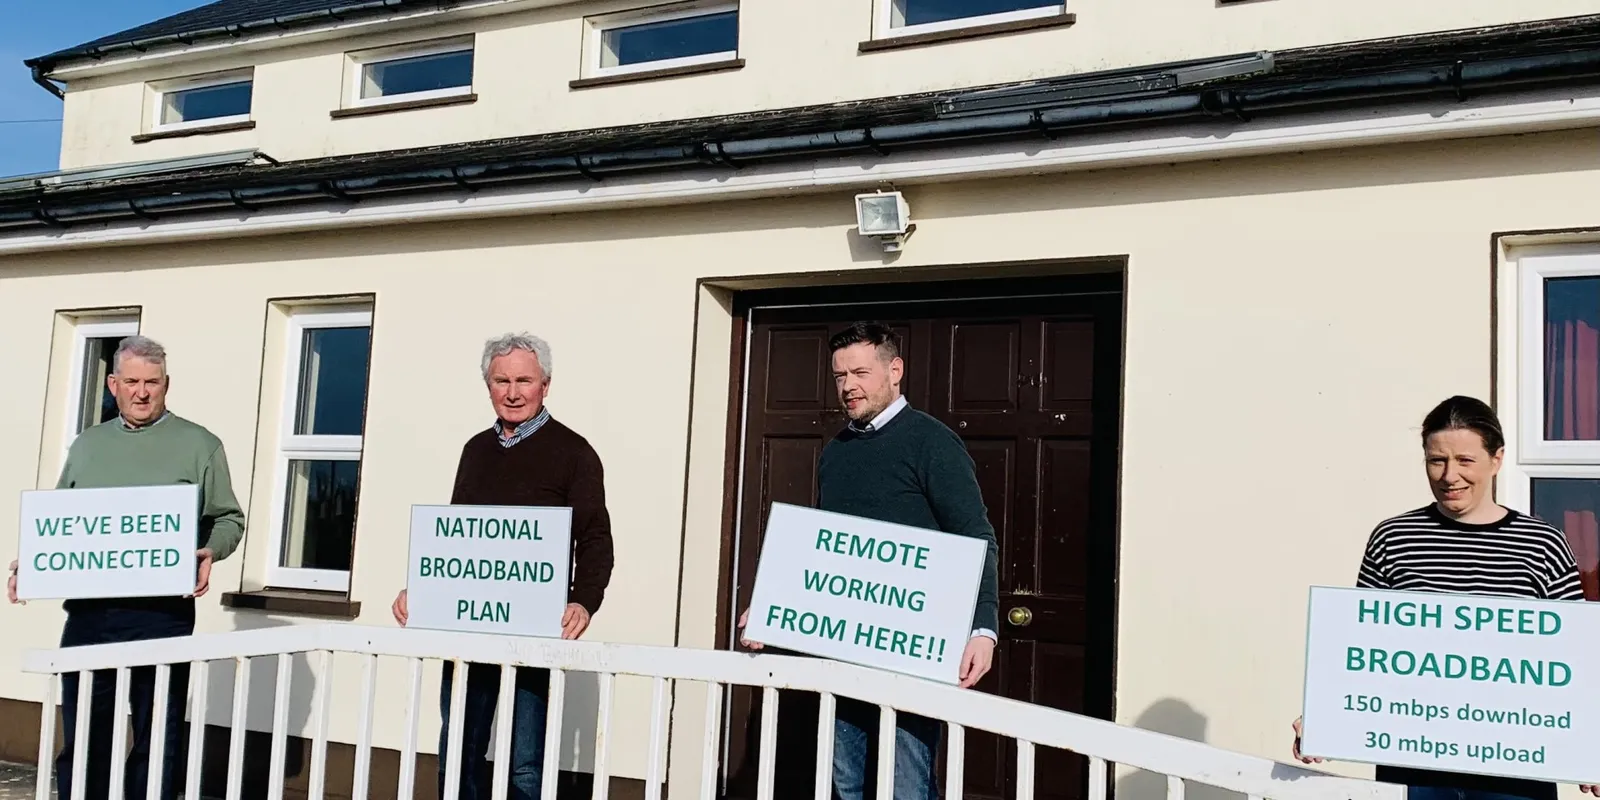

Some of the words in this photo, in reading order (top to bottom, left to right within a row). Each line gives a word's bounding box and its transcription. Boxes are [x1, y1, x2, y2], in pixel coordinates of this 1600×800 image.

[120, 513, 181, 534] BEEN
[435, 517, 543, 541] NATIONAL
[33, 548, 180, 571] CONNECTED
[815, 528, 930, 570] REMOTE
[420, 556, 554, 583] BROADBAND
[804, 569, 926, 612] WORKING
[457, 599, 510, 623] PLAN
[1358, 599, 1442, 629] HIGH
[1454, 605, 1562, 636] SPEED
[766, 604, 847, 642] FROM
[854, 622, 946, 663] HERE!!
[1346, 646, 1572, 687] BROADBAND
[1343, 694, 1382, 713] 150
[1389, 698, 1450, 721] mbps
[1456, 703, 1571, 729] download
[1365, 731, 1391, 749] 30
[1398, 735, 1459, 758] mbps
[1466, 742, 1545, 764] upload
